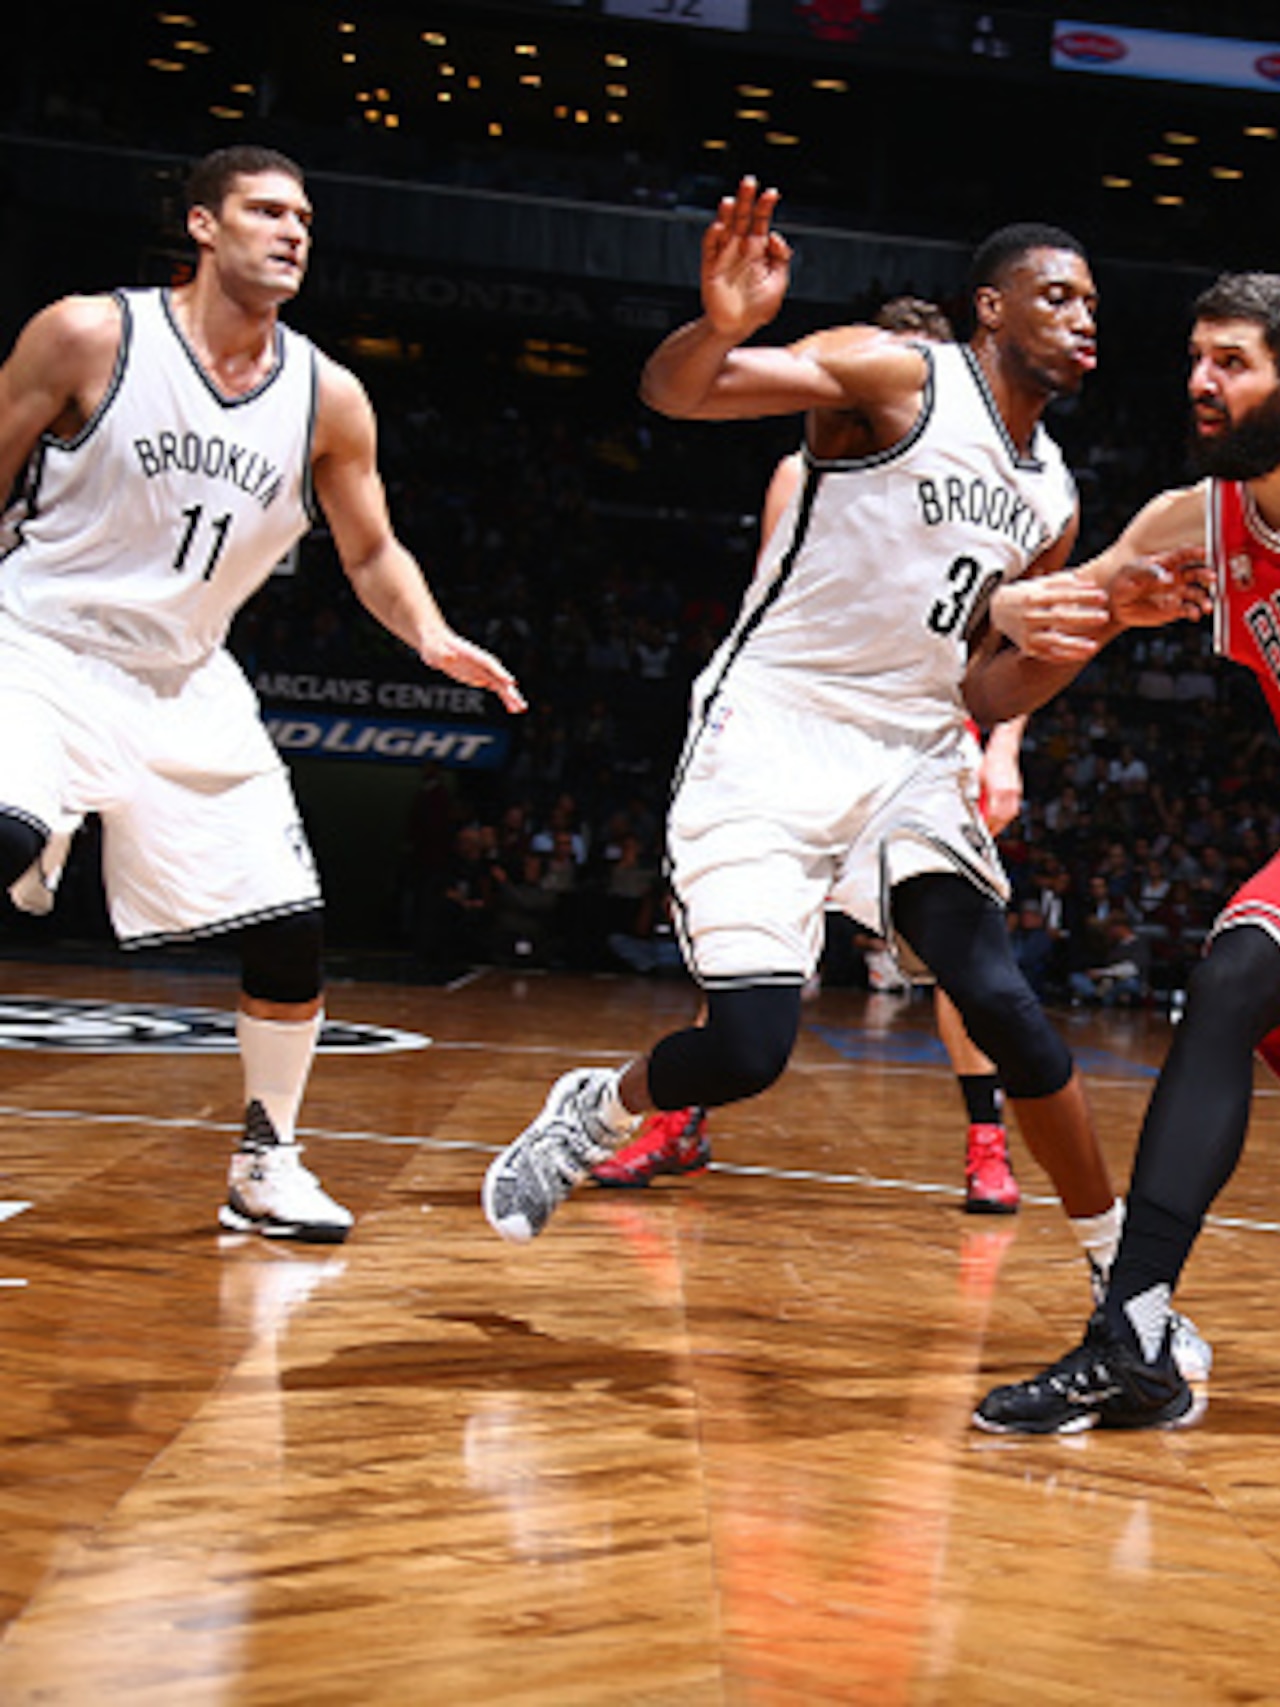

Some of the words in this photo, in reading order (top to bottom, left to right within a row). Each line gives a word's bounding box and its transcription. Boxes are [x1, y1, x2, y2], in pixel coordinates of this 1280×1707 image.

[364, 270, 595, 322] HONDA
[133, 431, 284, 510] BROOKLYN
[172, 504, 232, 581] 11
[919, 476, 1050, 552] BROOKLY
[255, 671, 372, 705] ARCLAYS
[377, 683, 487, 715] CENTER
[321, 721, 496, 761] LIGHT
